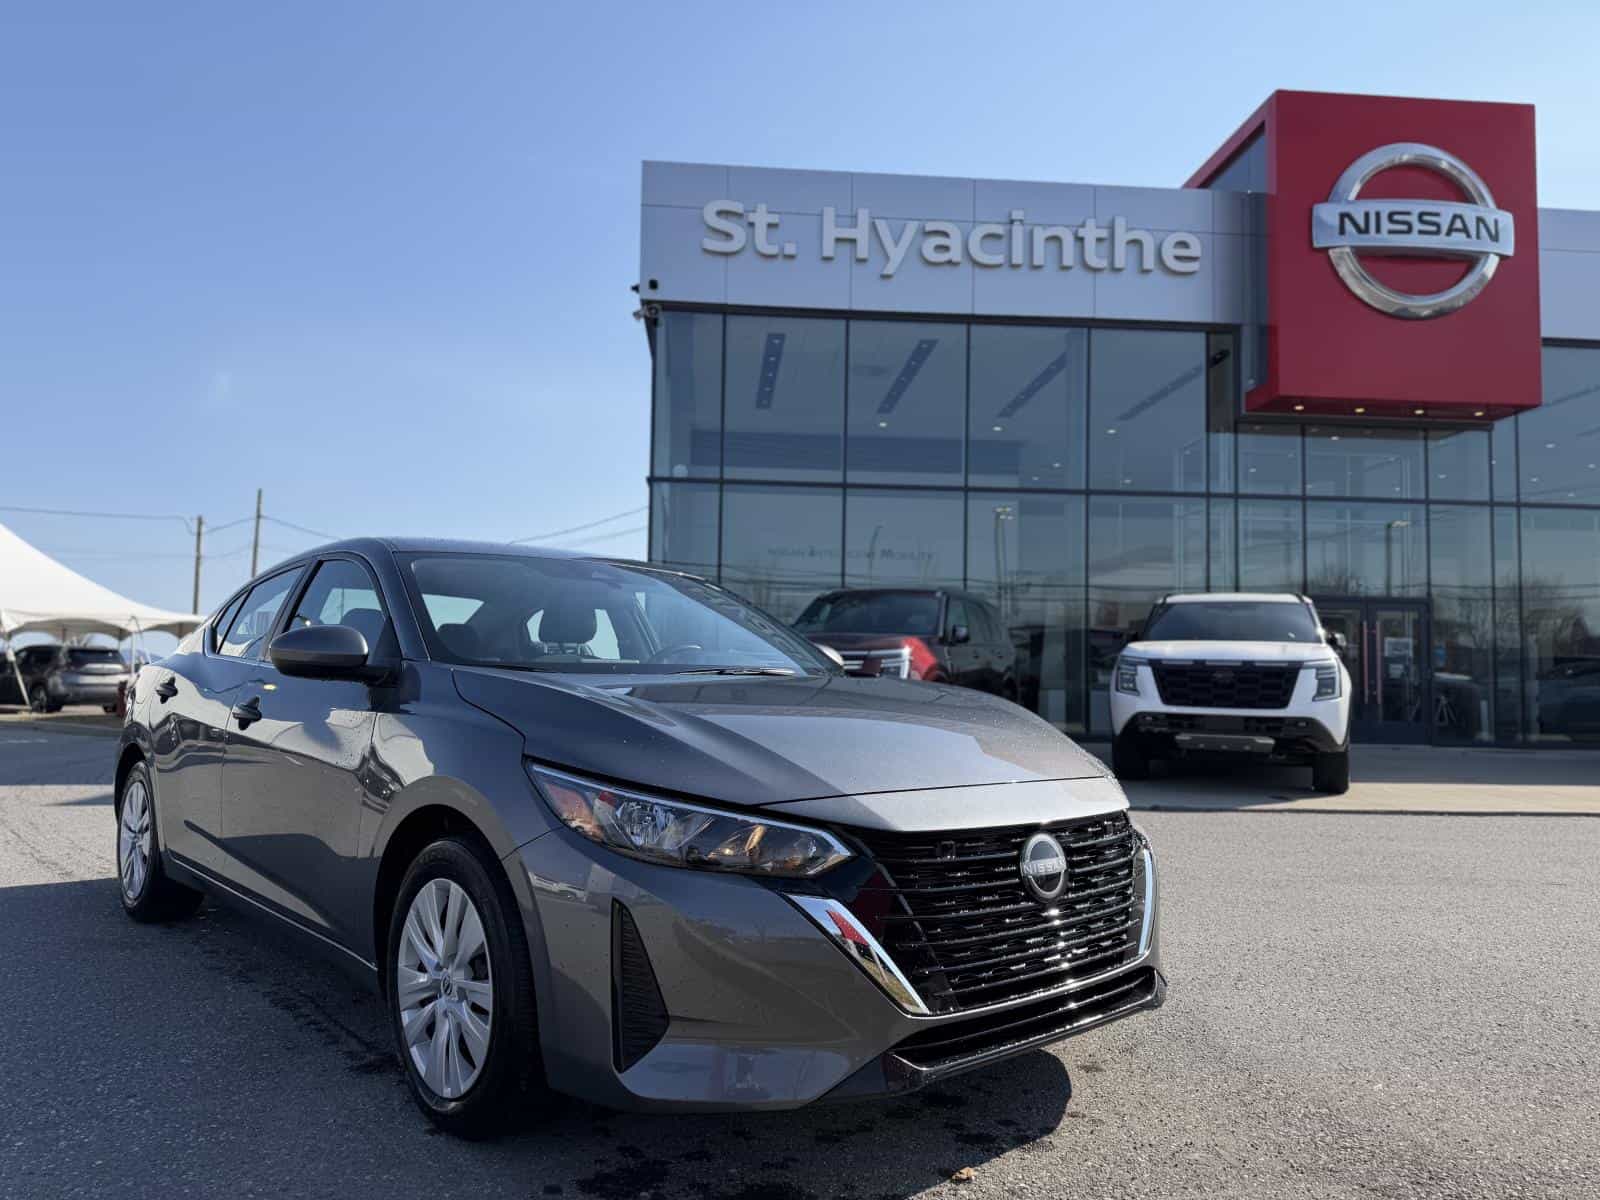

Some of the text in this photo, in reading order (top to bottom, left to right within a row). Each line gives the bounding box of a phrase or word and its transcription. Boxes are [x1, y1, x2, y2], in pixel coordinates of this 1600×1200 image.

[702, 200, 1202, 277] St. Hyacinthe
[1338, 210, 1500, 243] NISSAN
